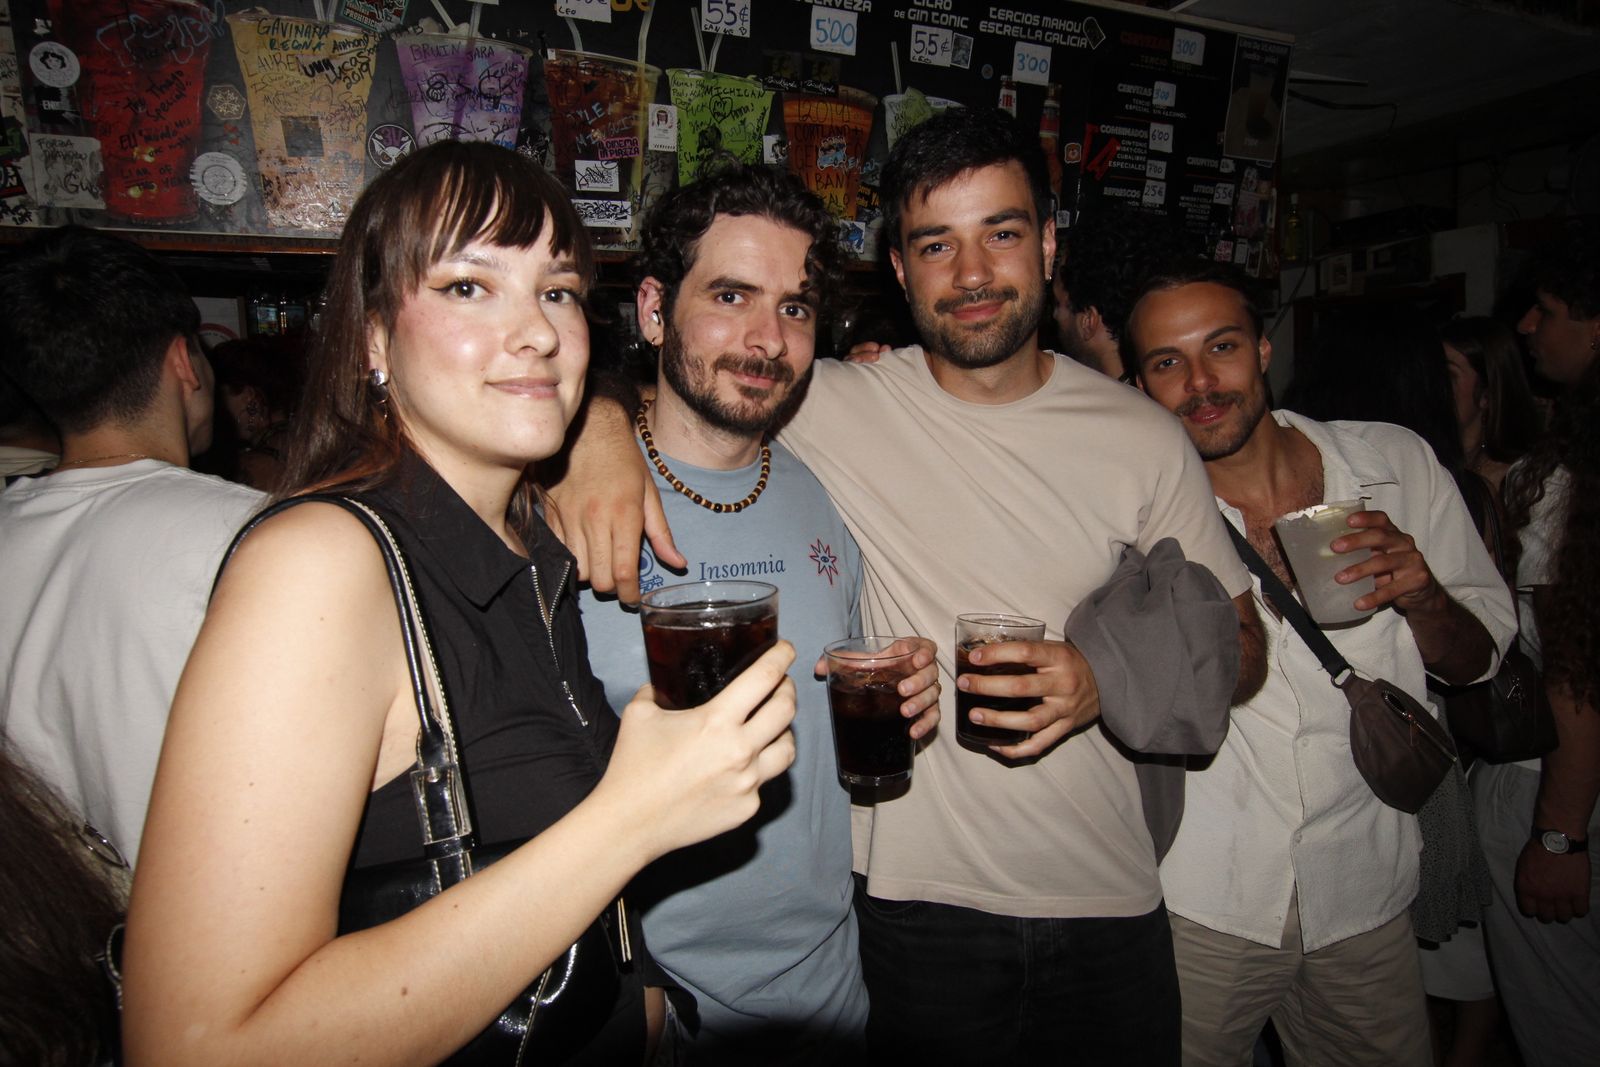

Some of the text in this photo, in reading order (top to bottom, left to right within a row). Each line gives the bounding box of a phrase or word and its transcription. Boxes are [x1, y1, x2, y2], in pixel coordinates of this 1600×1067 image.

[893, 7, 970, 29] DE GIN TONIC
[989, 6, 1082, 33] TERCIOS MAHOU
[979, 20, 1088, 49] ESTRELLA GALICIA
[1016, 53, 1049, 74] 3'00
[606, 138, 639, 150] CINEMA
[609, 147, 640, 158] PIAZZA
[1108, 160, 1146, 171] ESPECIALES
[698, 553, 786, 581] Insomnia
